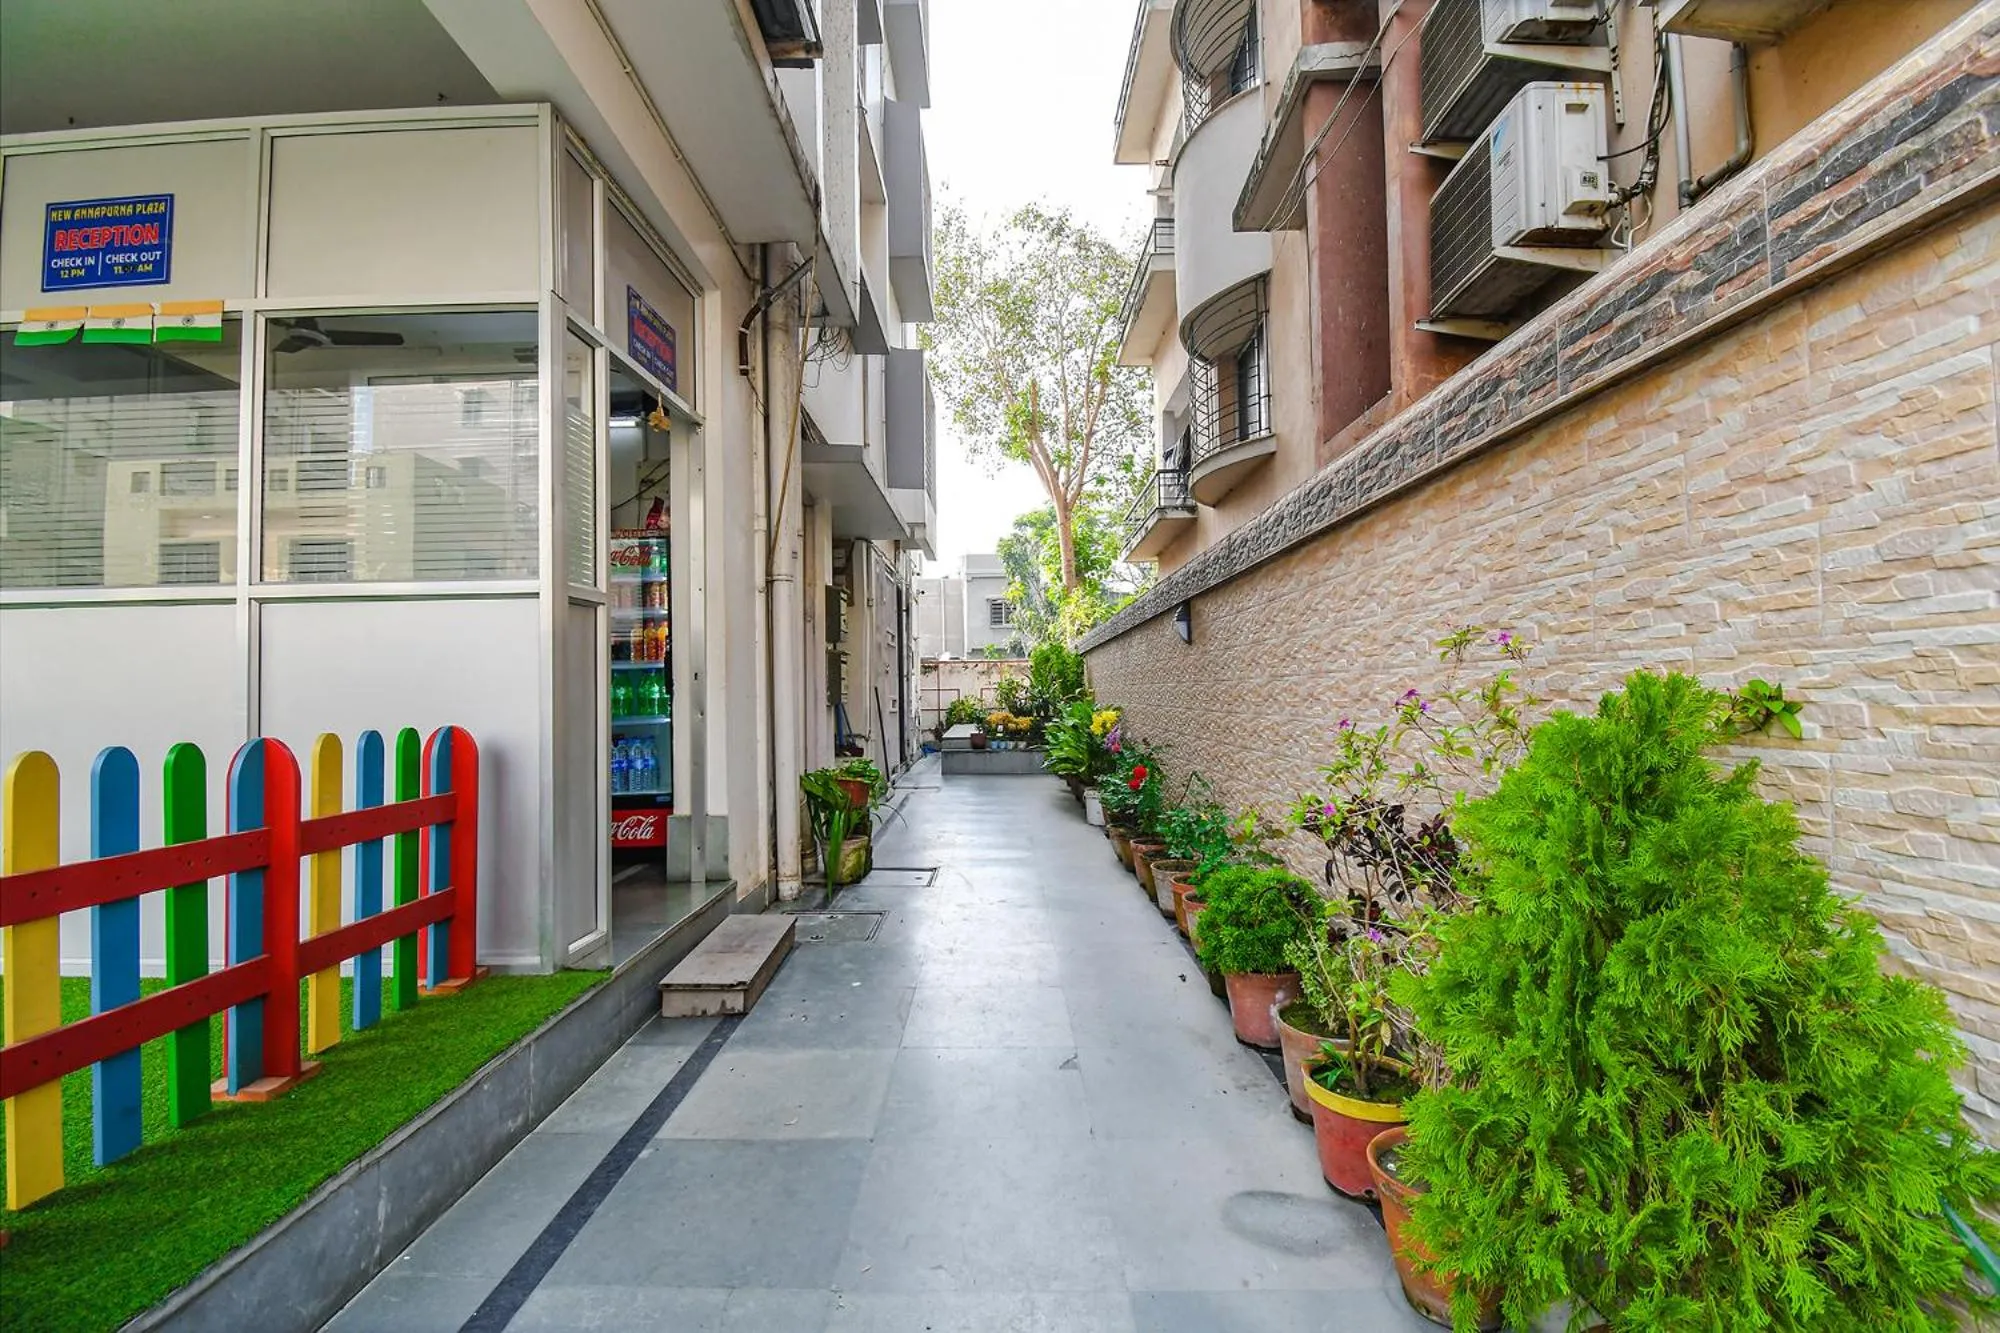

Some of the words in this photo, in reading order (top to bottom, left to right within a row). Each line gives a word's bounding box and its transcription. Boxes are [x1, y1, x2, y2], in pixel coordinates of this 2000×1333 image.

[51, 210, 71, 222] NEW
[74, 204, 133, 220] ANNAPURNA
[136, 202, 165, 215] PLAZA
[55, 223, 159, 251] RECEPTION
[51, 258, 82, 269] CHECK
[84, 255, 96, 265] IN
[105, 252, 138, 264] CHECK
[140, 251, 162, 261] OUT
[60, 269, 69, 279] 12
[71, 268, 85, 278] PM
[137, 263, 153, 273] AM
